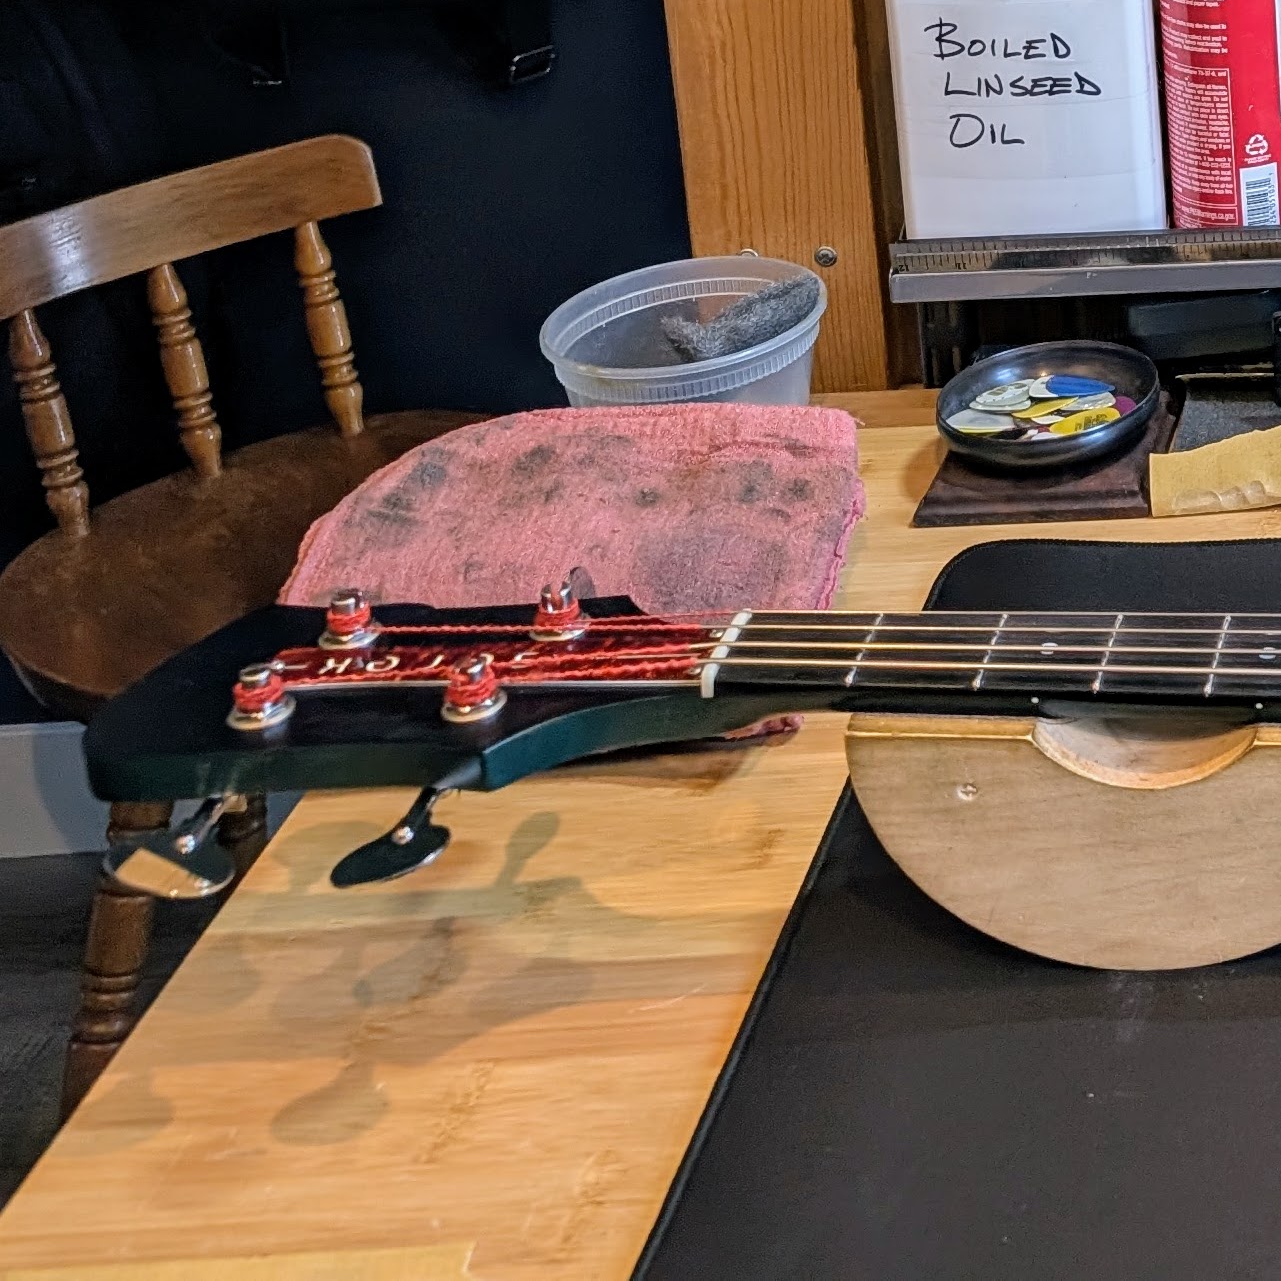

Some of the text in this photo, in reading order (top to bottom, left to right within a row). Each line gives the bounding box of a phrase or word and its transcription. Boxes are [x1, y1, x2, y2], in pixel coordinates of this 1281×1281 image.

[924, 18, 1072, 61] BOILED
[943, 71, 1102, 98] LINSEED
[949, 113, 1026, 149] OIL
